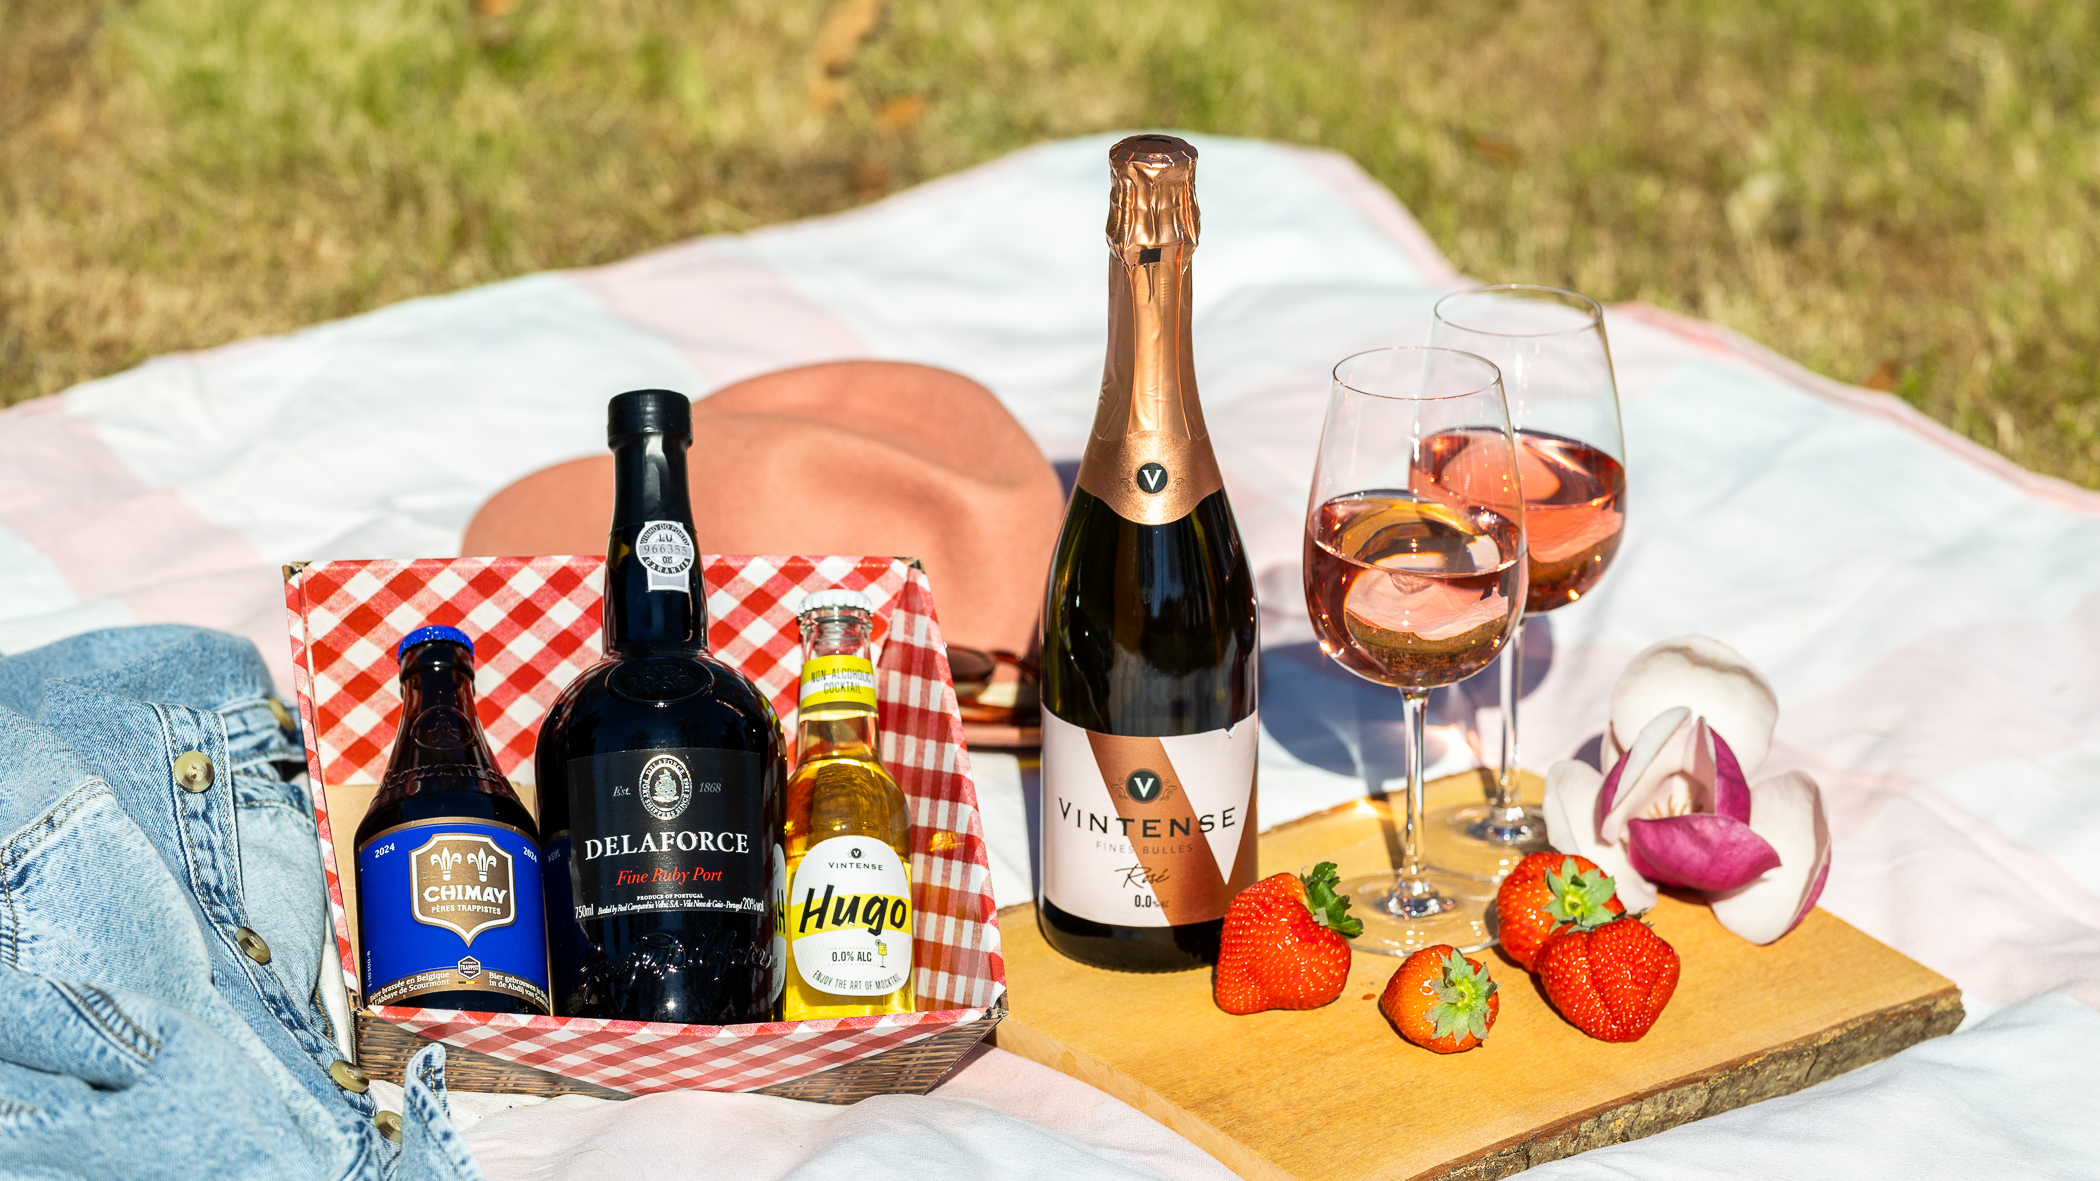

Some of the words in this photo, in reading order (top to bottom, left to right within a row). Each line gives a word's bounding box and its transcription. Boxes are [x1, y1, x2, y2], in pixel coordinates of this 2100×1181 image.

[1142, 469, 1163, 491] V
[643, 544, 688, 556] 966355
[645, 559, 690, 575] GARANTIA
[823, 681, 862, 694] COCKTAIL
[612, 786, 632, 797] Est.
[699, 782, 722, 793] 1868
[1134, 777, 1155, 798] V
[1058, 797, 1236, 838] VINTENSE
[374, 843, 396, 858] 2024
[585, 831, 750, 861] DELAFORCE
[1096, 841, 1135, 854] FINES
[1142, 843, 1194, 855] BULLES
[523, 846, 538, 863] 2024
[829, 862, 884, 871] VINTENSE
[615, 870, 648, 886] Fine
[650, 866, 690, 885] Ruby
[692, 866, 723, 882] Port
[1114, 863, 1170, 888] Rosé
[423, 885, 508, 904] CHIMAY
[636, 893, 664, 901] PRODUCE
[431, 903, 456, 914] PÈRES
[457, 905, 502, 915] TRAPPISTES
[574, 903, 594, 919] 750ml
[799, 884, 907, 937] Hugo
[831, 951, 855, 962] 0.0%
[857, 951, 872, 962] ALC
[382, 980, 406, 994] brassée
[416, 972, 450, 983] Belgique
[398, 986, 408, 995] de
[408, 979, 450, 992] Scourmont
[488, 972, 503, 980] Bier
[504, 975, 536, 991] gebrouwen
[812, 969, 834, 987] ENJOY
[835, 978, 847, 990] THE
[850, 979, 862, 991] ART
[864, 980, 873, 991] OF
[875, 973, 902, 990] MOCKTAIL
[489, 979, 497, 987] in
[497, 980, 507, 988] de
[507, 983, 525, 995] Abdij
[525, 988, 535, 998] van
